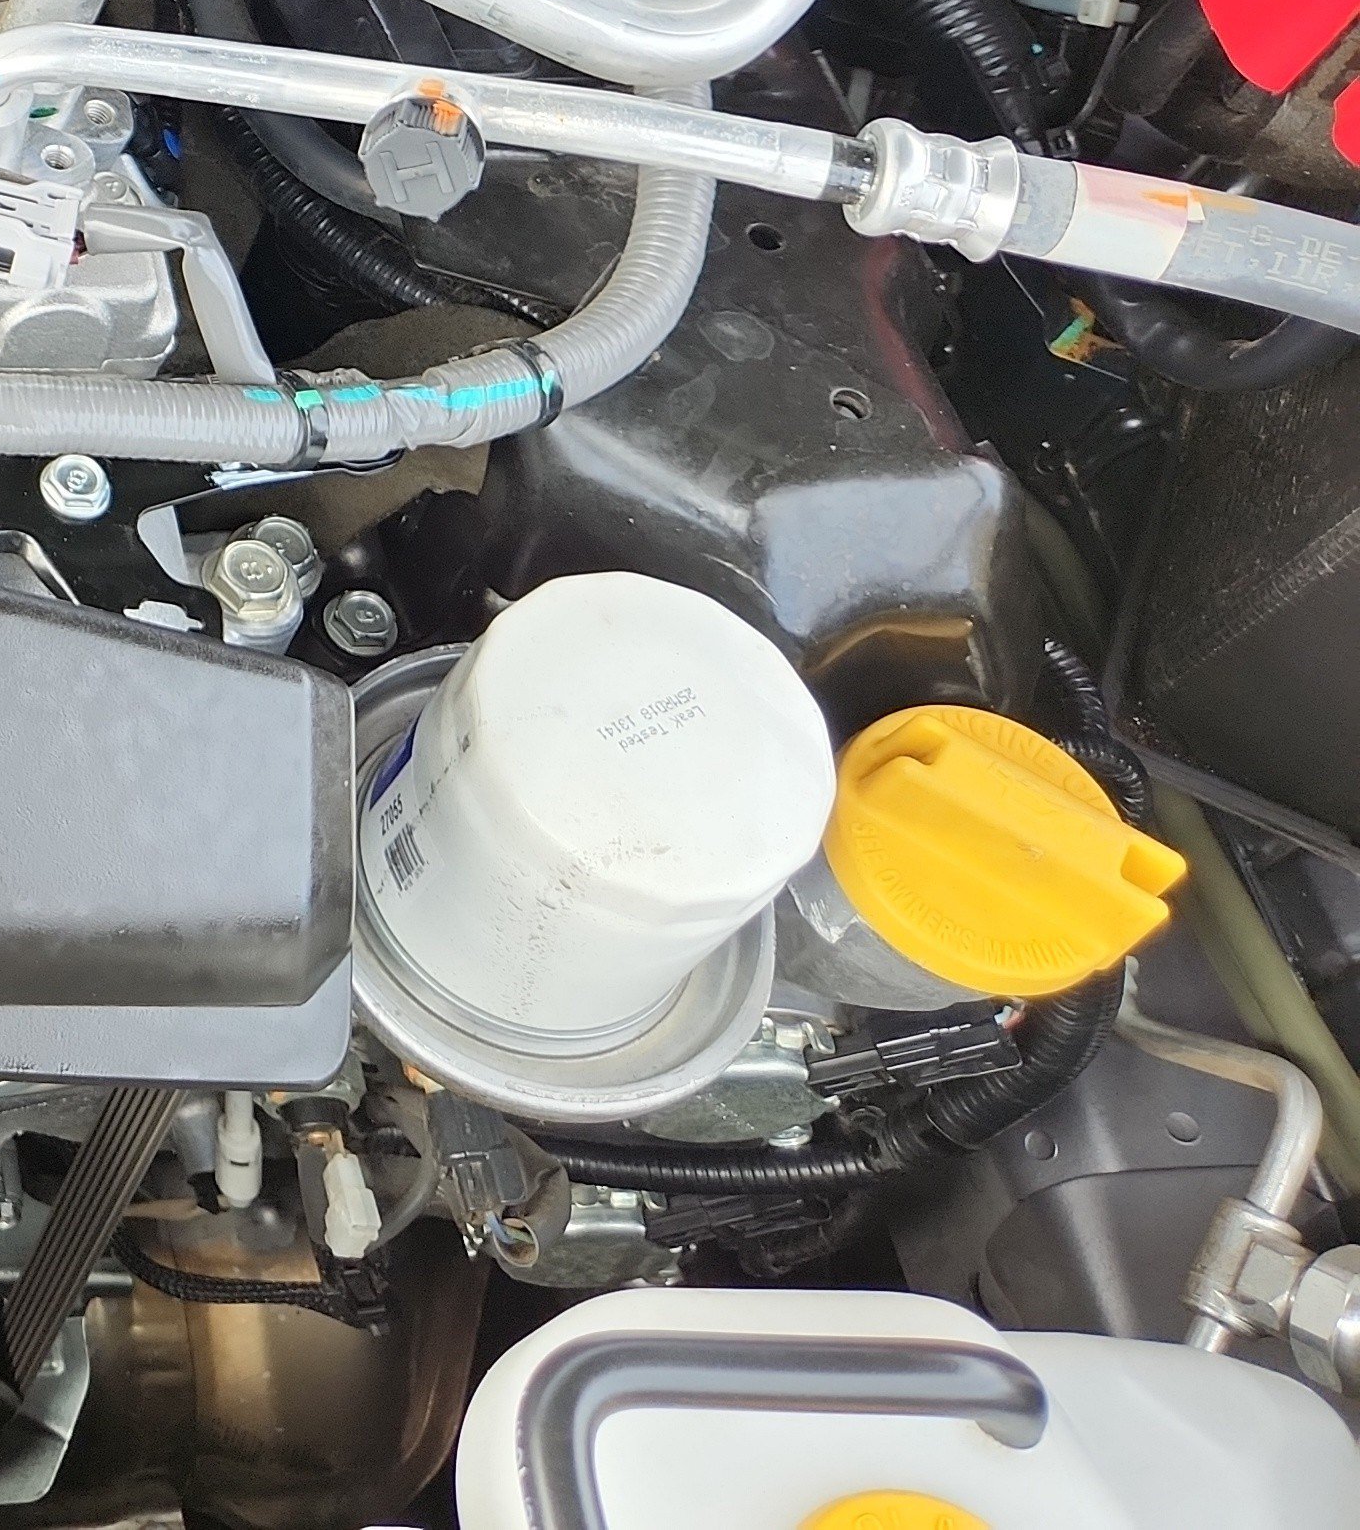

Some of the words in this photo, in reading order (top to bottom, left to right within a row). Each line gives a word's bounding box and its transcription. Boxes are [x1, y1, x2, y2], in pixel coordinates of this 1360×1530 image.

[380, 141, 455, 204] H
[596, 714, 636, 740] 13141
[618, 722, 669, 753] Tested
[851, 820, 888, 869] SEE
[874, 867, 977, 954] OWNER'S
[982, 936, 1083, 969] MANUAL
